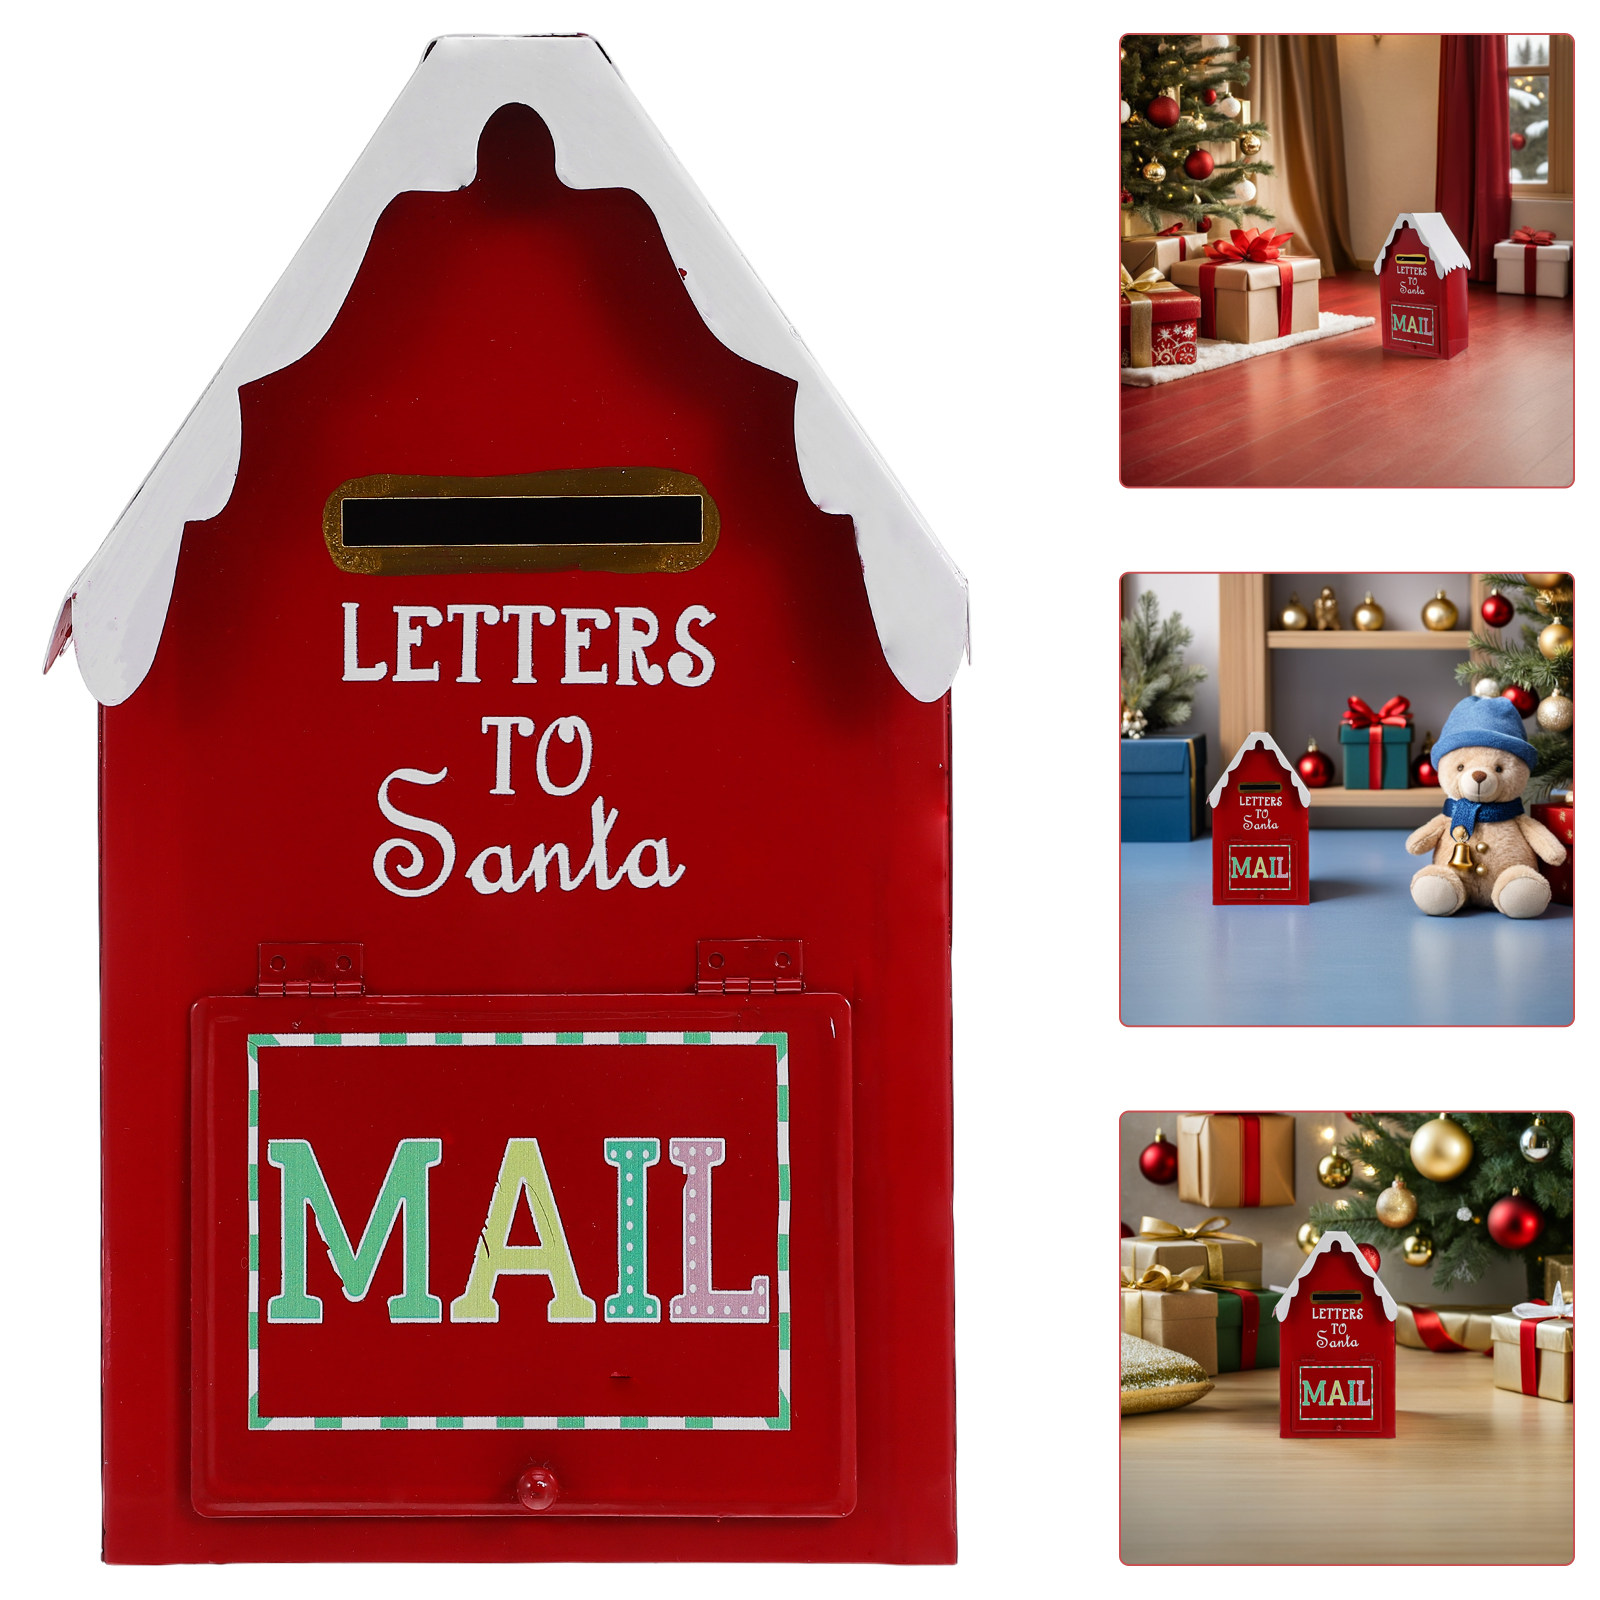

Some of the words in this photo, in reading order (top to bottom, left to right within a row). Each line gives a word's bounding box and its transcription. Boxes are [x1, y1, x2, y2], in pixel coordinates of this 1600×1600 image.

[1396, 265, 1428, 277] LETTERS
[1399, 280, 1425, 295] Santa
[1407, 277, 1418, 286] TO
[1392, 313, 1433, 337] MAIL
[342, 602, 716, 687] LETTERS
[482, 716, 593, 797] TO
[1239, 795, 1283, 807] LETTERS
[1243, 814, 1279, 831] Santa
[1255, 808, 1269, 820] TO
[373, 768, 685, 897] Santa
[1231, 856, 1289, 879] MAIL
[267, 1137, 769, 1324] MAIL
[1312, 1307, 1364, 1321] LETTERS
[1331, 1322, 1347, 1335] TO
[1316, 1329, 1359, 1349] Santa
[1302, 1379, 1371, 1407] MAIL
